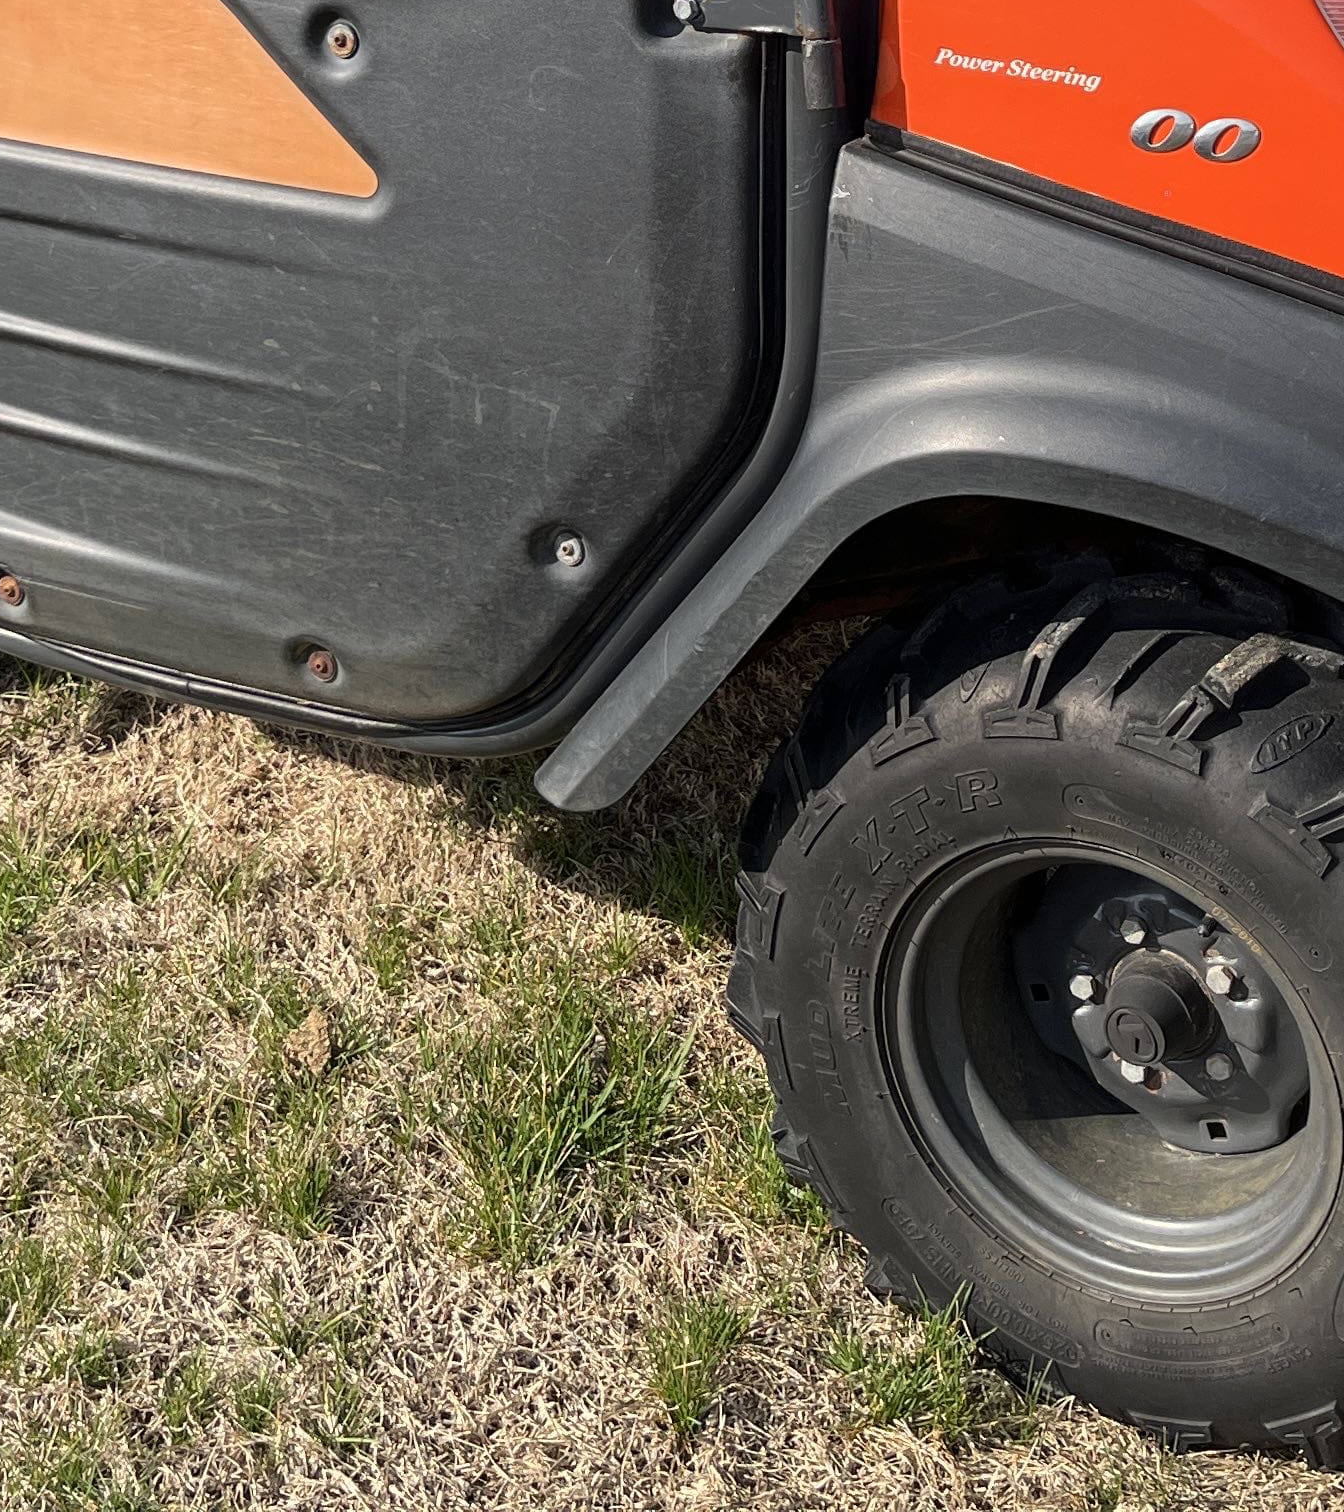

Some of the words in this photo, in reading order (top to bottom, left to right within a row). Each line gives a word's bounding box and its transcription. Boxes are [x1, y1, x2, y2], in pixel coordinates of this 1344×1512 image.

[933, 46, 1006, 74] Power
[1006, 58, 1103, 93] Steering
[1262, 719, 1316, 763] ITP
[894, 829, 957, 875] RADIAL
[849, 874, 900, 949] TERRAIN
[841, 964, 864, 1044] XTREME
